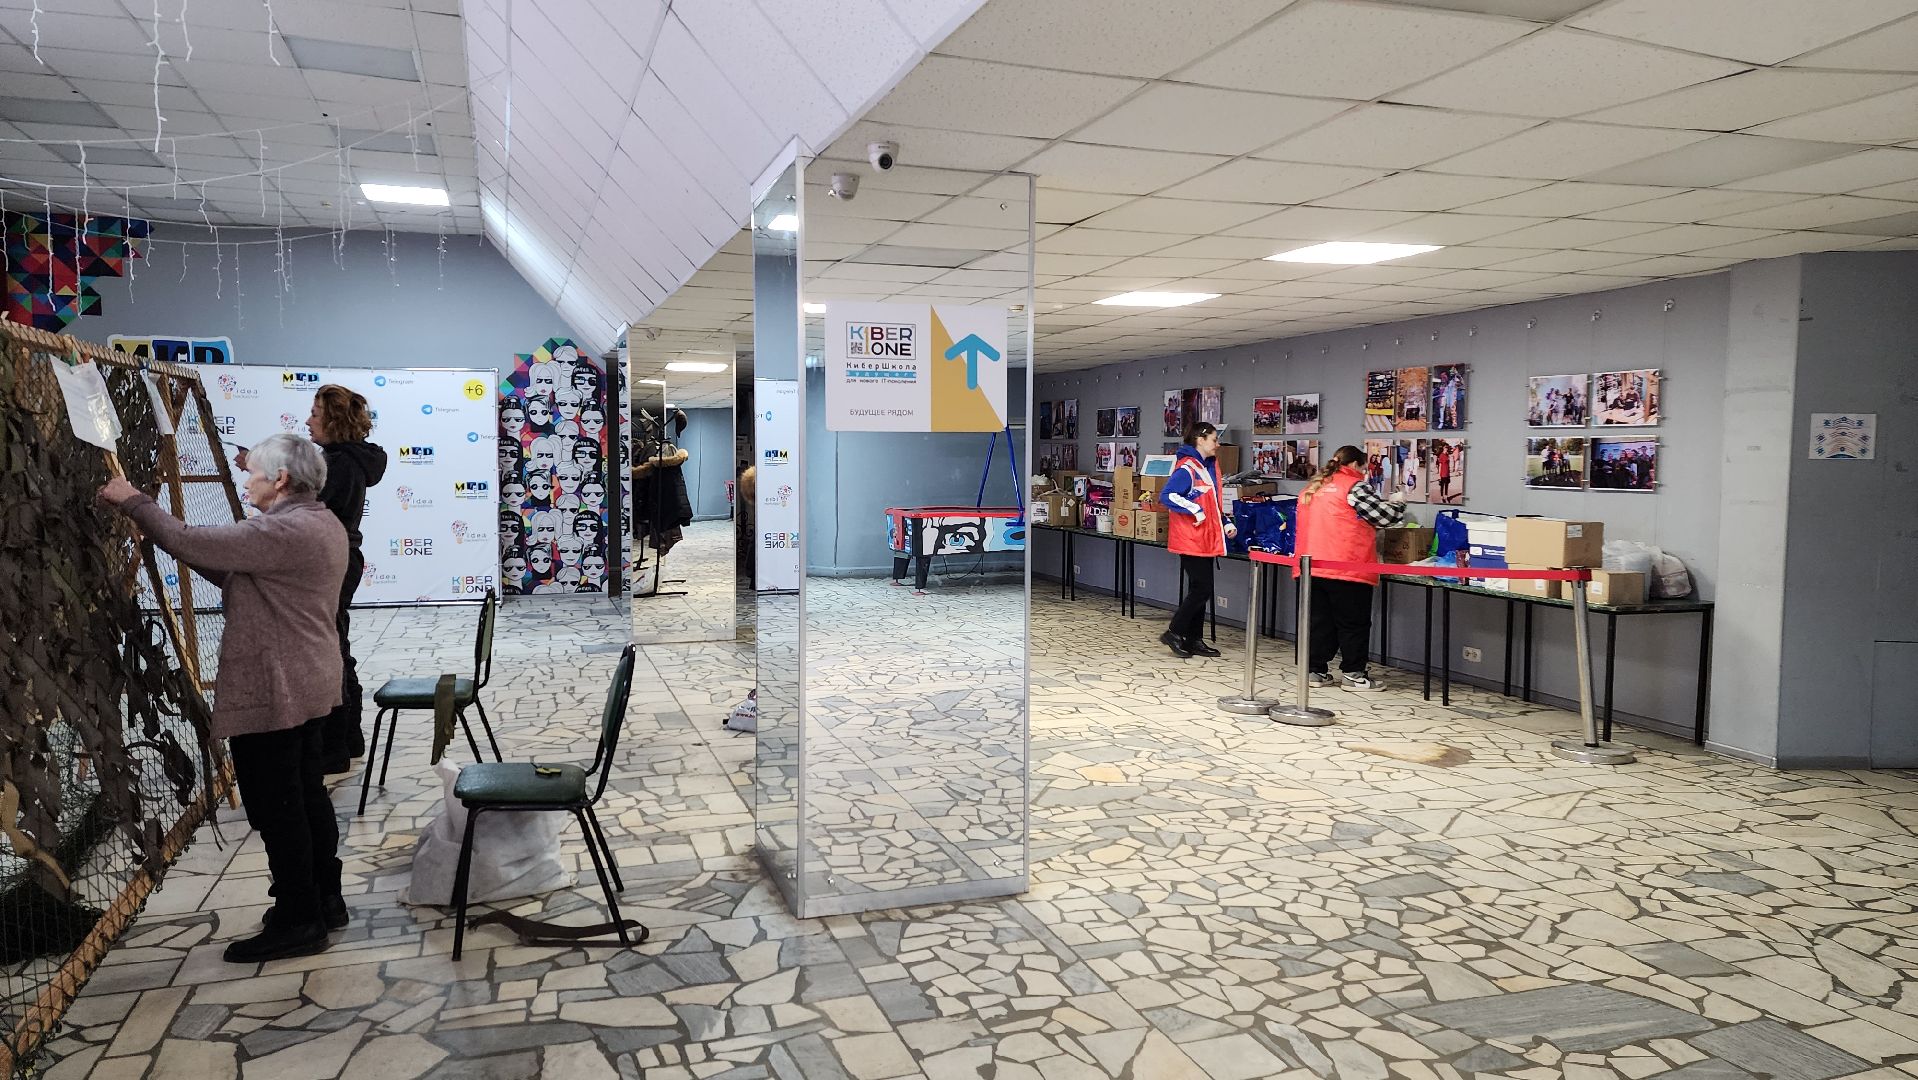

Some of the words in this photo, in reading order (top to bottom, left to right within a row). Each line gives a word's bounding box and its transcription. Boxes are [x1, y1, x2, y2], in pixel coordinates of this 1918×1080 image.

[871, 342, 912, 356] ONE
[846, 362, 917, 371] КиберШкола
[465, 384, 483, 396] +6
